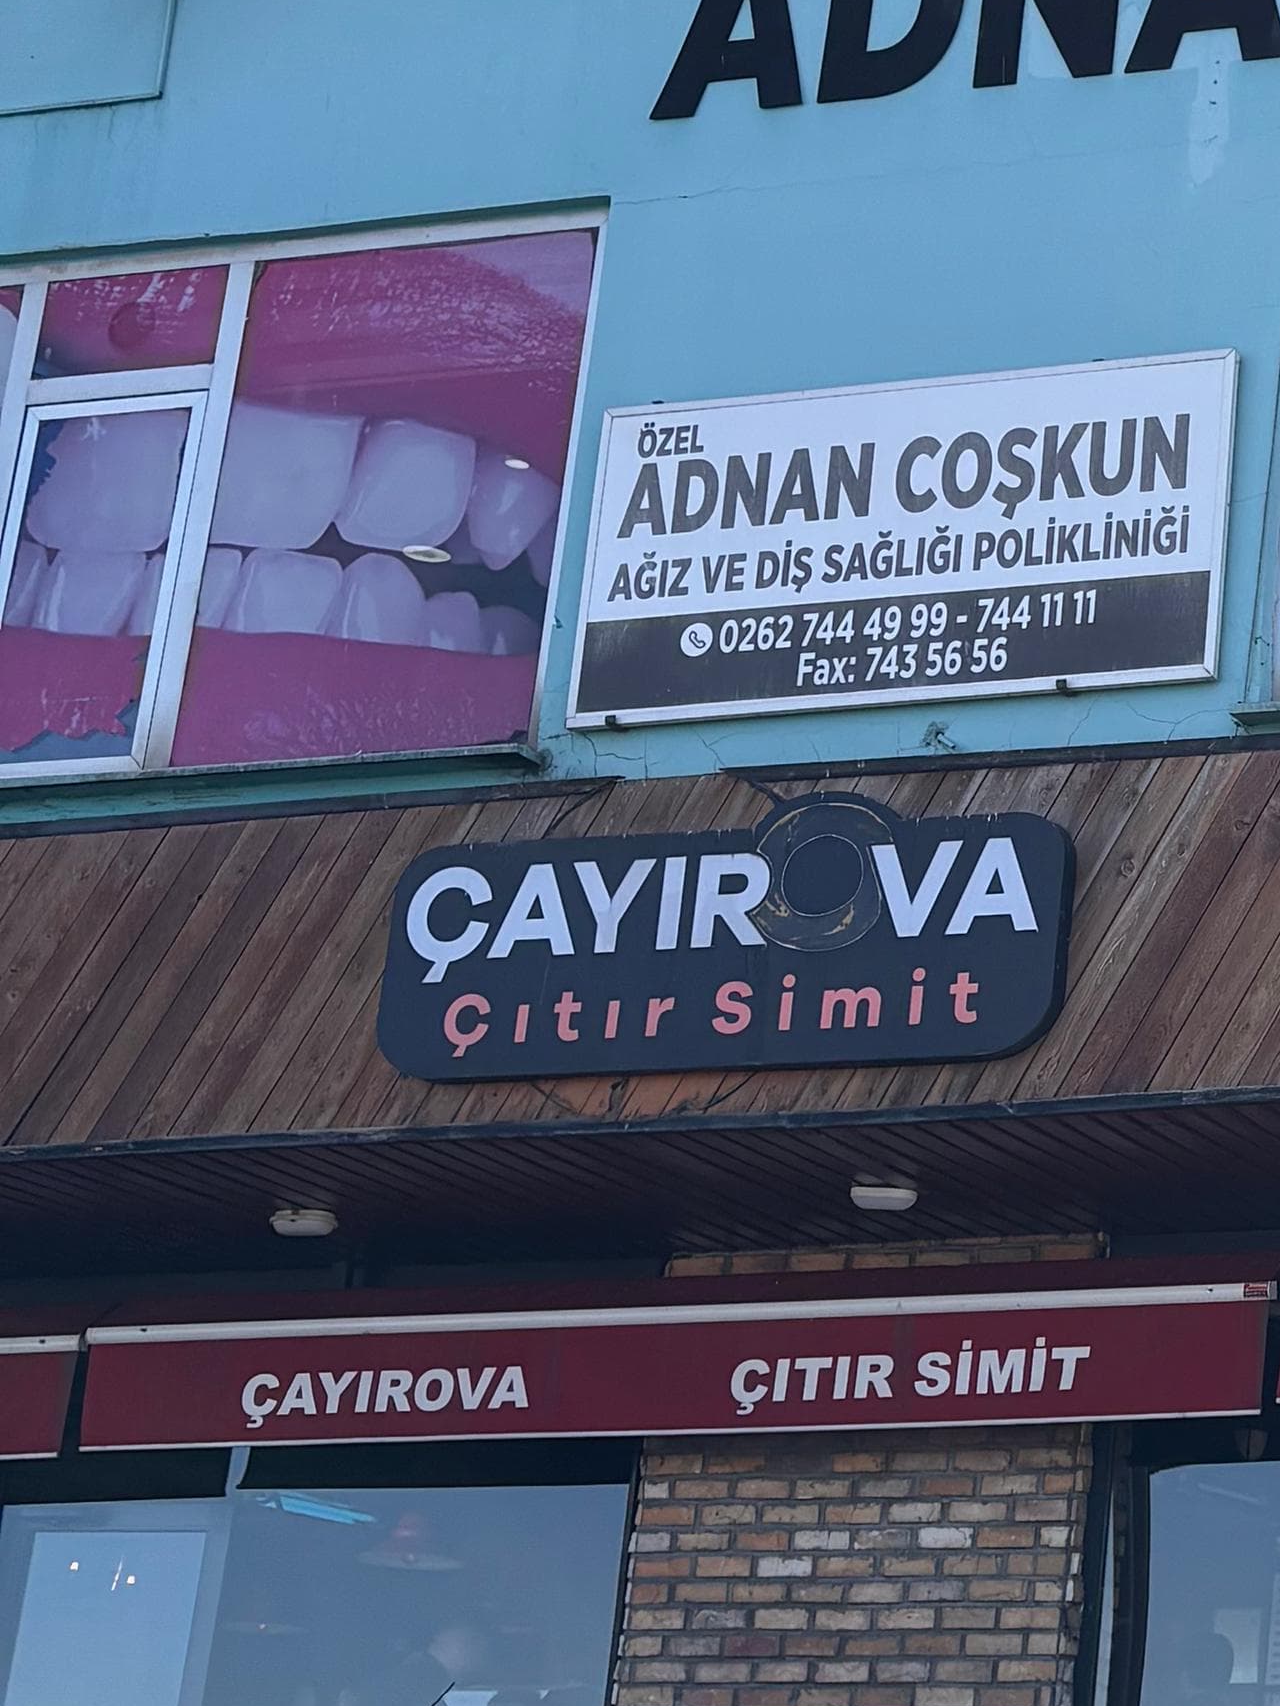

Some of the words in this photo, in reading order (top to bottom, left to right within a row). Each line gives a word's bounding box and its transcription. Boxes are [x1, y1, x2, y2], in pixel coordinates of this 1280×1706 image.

[616, 442, 876, 539] ADNAN
[894, 413, 1191, 520] COŞKUN
[637, 422, 704, 458] ÖZEL
[607, 550, 690, 602] AĞIZ
[702, 552, 747, 594] VE
[754, 539, 812, 593] DİŞ
[823, 525, 963, 583] SAĞLIĞI
[972, 505, 1191, 571] POLİKLİNİĞİ
[718, 616, 793, 654] 0262
[802, 611, 855, 648] 744
[862, 607, 903, 642] 49
[908, 603, 947, 638] 99
[977, 595, 1031, 633] 744
[1039, 591, 1064, 627] 11
[1072, 588, 1097, 624] 11
[796, 651, 856, 687] Fax:
[865, 645, 917, 682] 743
[924, 641, 964, 676] 56
[971, 637, 1009, 673] 56
[442, 990, 676, 1057] Çıtır
[711, 967, 980, 1034] Simit
[240, 1365, 531, 1428] ÇAYIROVA
[729, 1353, 895, 1416] ÇITIR
[914, 1336, 1091, 1398] SİMİT
